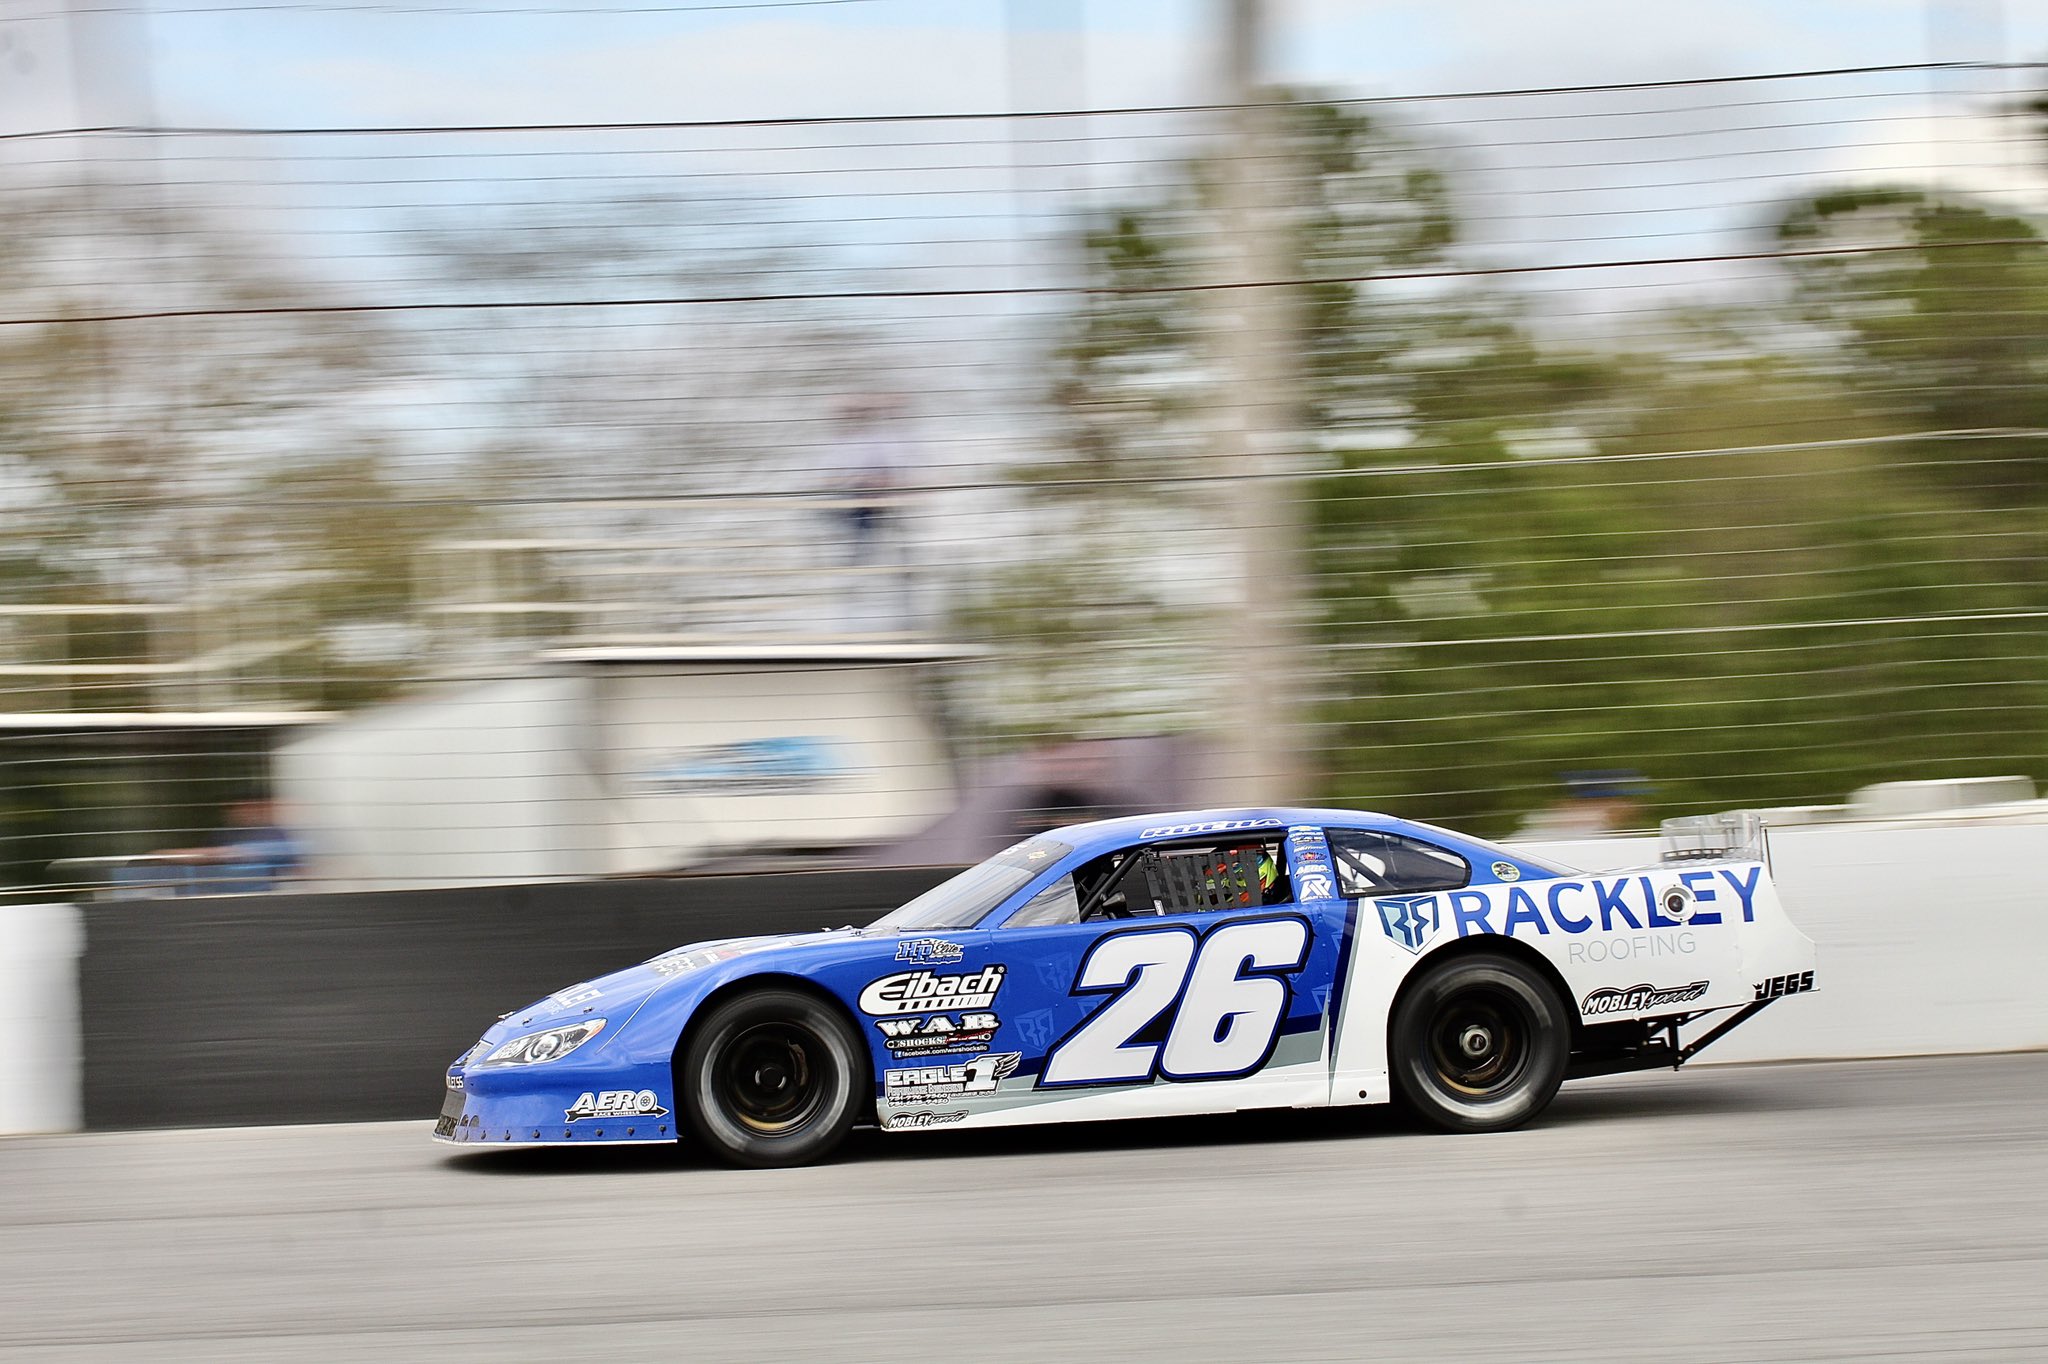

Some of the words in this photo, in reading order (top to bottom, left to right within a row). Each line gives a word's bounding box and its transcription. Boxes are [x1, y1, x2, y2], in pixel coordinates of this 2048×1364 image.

[1447, 866, 1761, 938] RACKLEY
[1568, 931, 1697, 965] ROOFING
[859, 967, 1003, 1015] Eibach
[1042, 918, 1308, 1086] 26
[1756, 970, 1815, 1000] JEGS
[1583, 990, 1650, 1015] MOBLEY
[900, 1036, 942, 1048] SHOCKS
[886, 1066, 967, 1086] EAGLE
[965, 1056, 1000, 1091] 1
[570, 1090, 657, 1112] AERO
